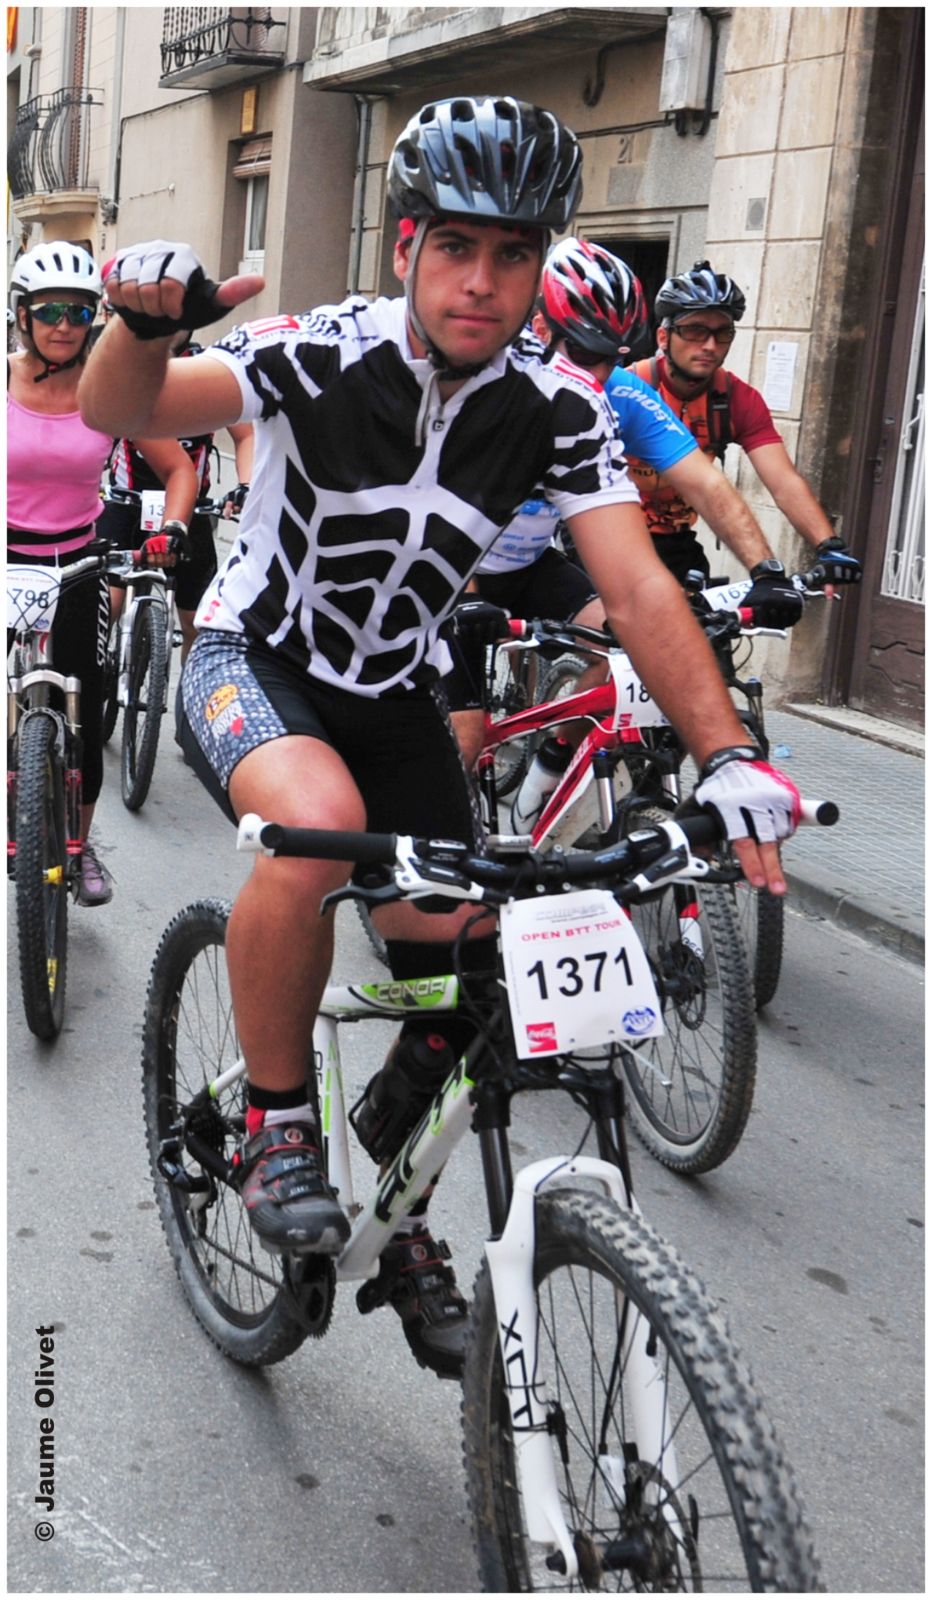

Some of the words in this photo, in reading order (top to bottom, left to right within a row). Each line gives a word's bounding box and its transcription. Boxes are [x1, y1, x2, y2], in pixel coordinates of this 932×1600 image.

[617, 134, 635, 164] 21
[610, 385, 685, 436] GHOST
[521, 930, 561, 942] OPEN
[565, 925, 591, 938] BTT
[595, 918, 623, 930] TOUR
[526, 946, 633, 1000] 1371
[376, 976, 445, 1001] CONOR
